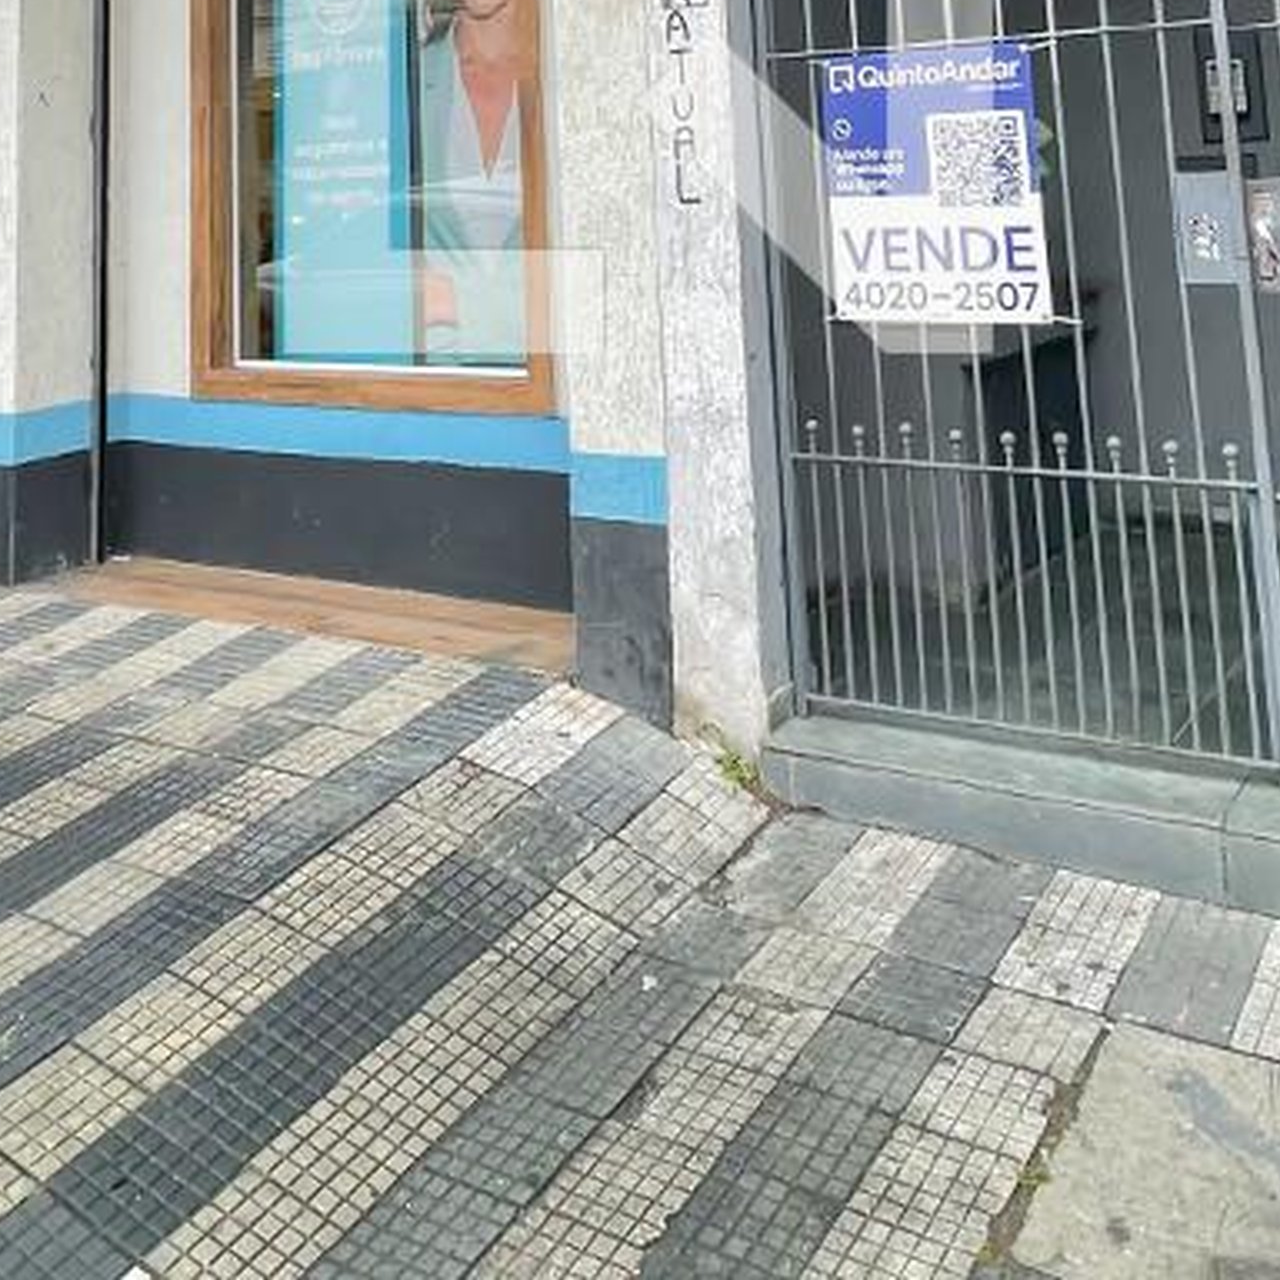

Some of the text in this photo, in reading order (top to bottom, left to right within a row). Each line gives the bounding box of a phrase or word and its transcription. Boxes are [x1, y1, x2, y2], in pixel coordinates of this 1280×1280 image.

[857, 57, 1021, 88] QuintoAndar
[842, 225, 1037, 272] VENDE
[844, 281, 1039, 312] 4020-2507
